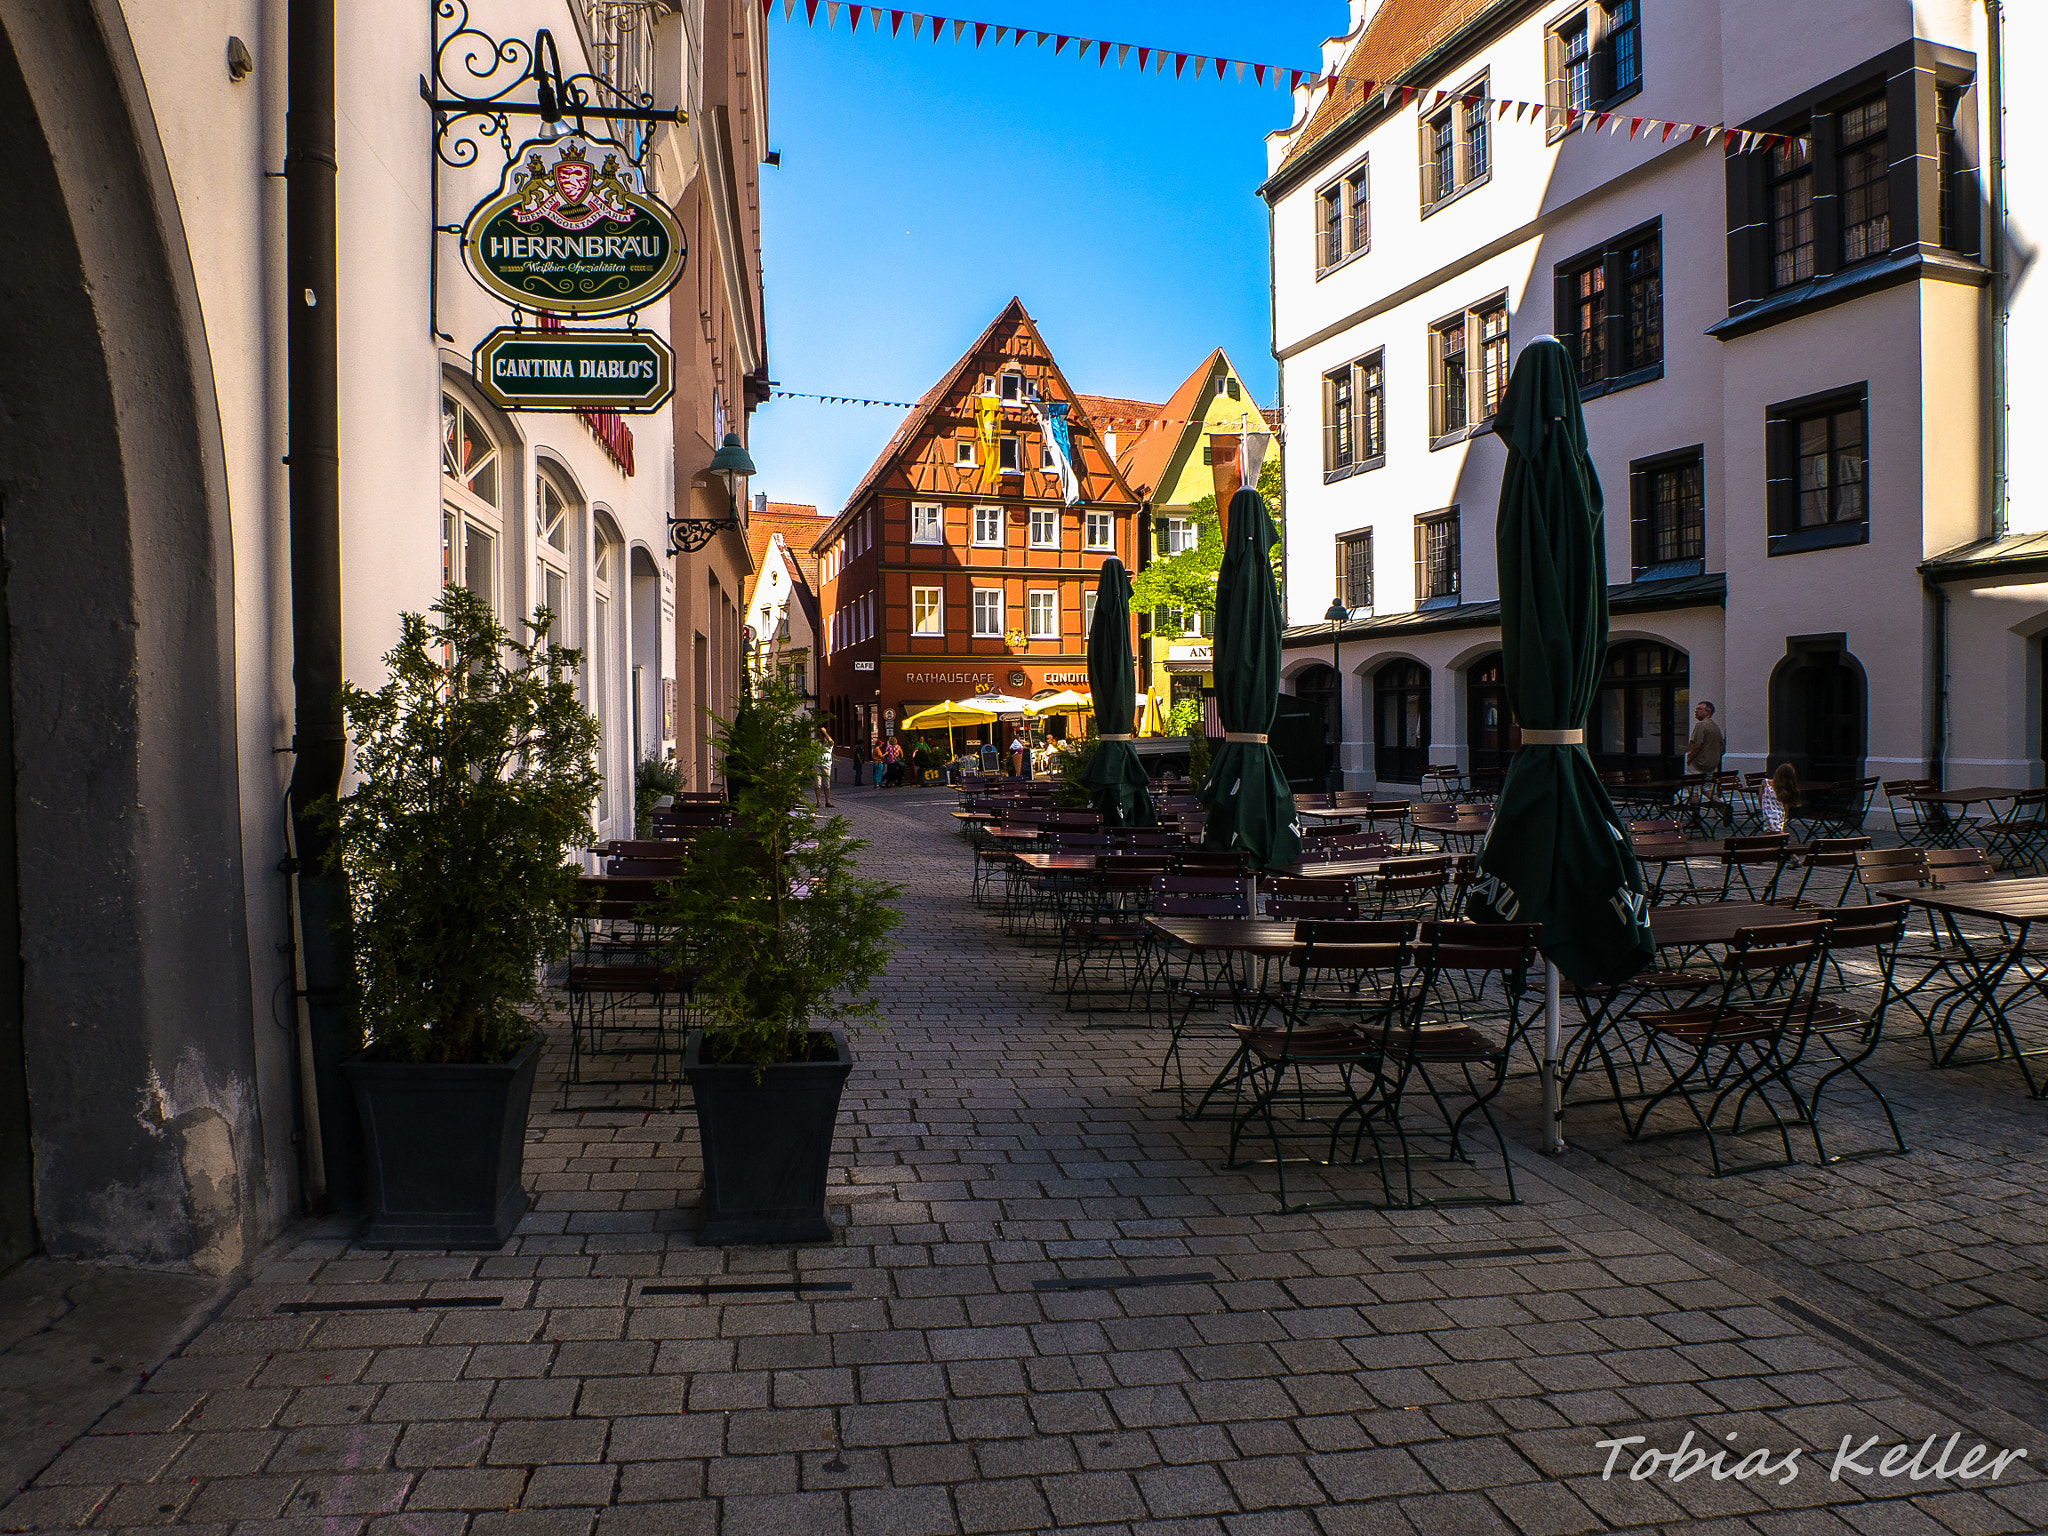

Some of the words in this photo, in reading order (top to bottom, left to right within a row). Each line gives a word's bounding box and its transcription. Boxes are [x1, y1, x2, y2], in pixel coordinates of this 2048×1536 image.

[519, 198, 556, 222] PREMIUM
[547, 210, 602, 229] INGOLSTADT
[593, 198, 630, 222] BAVARIA
[490, 236, 660, 259] HERRNBRÄU
[496, 359, 575, 378] CANTINA
[855, 662, 874, 670] CAFE
[906, 673, 995, 683] RATHAUSCAFE
